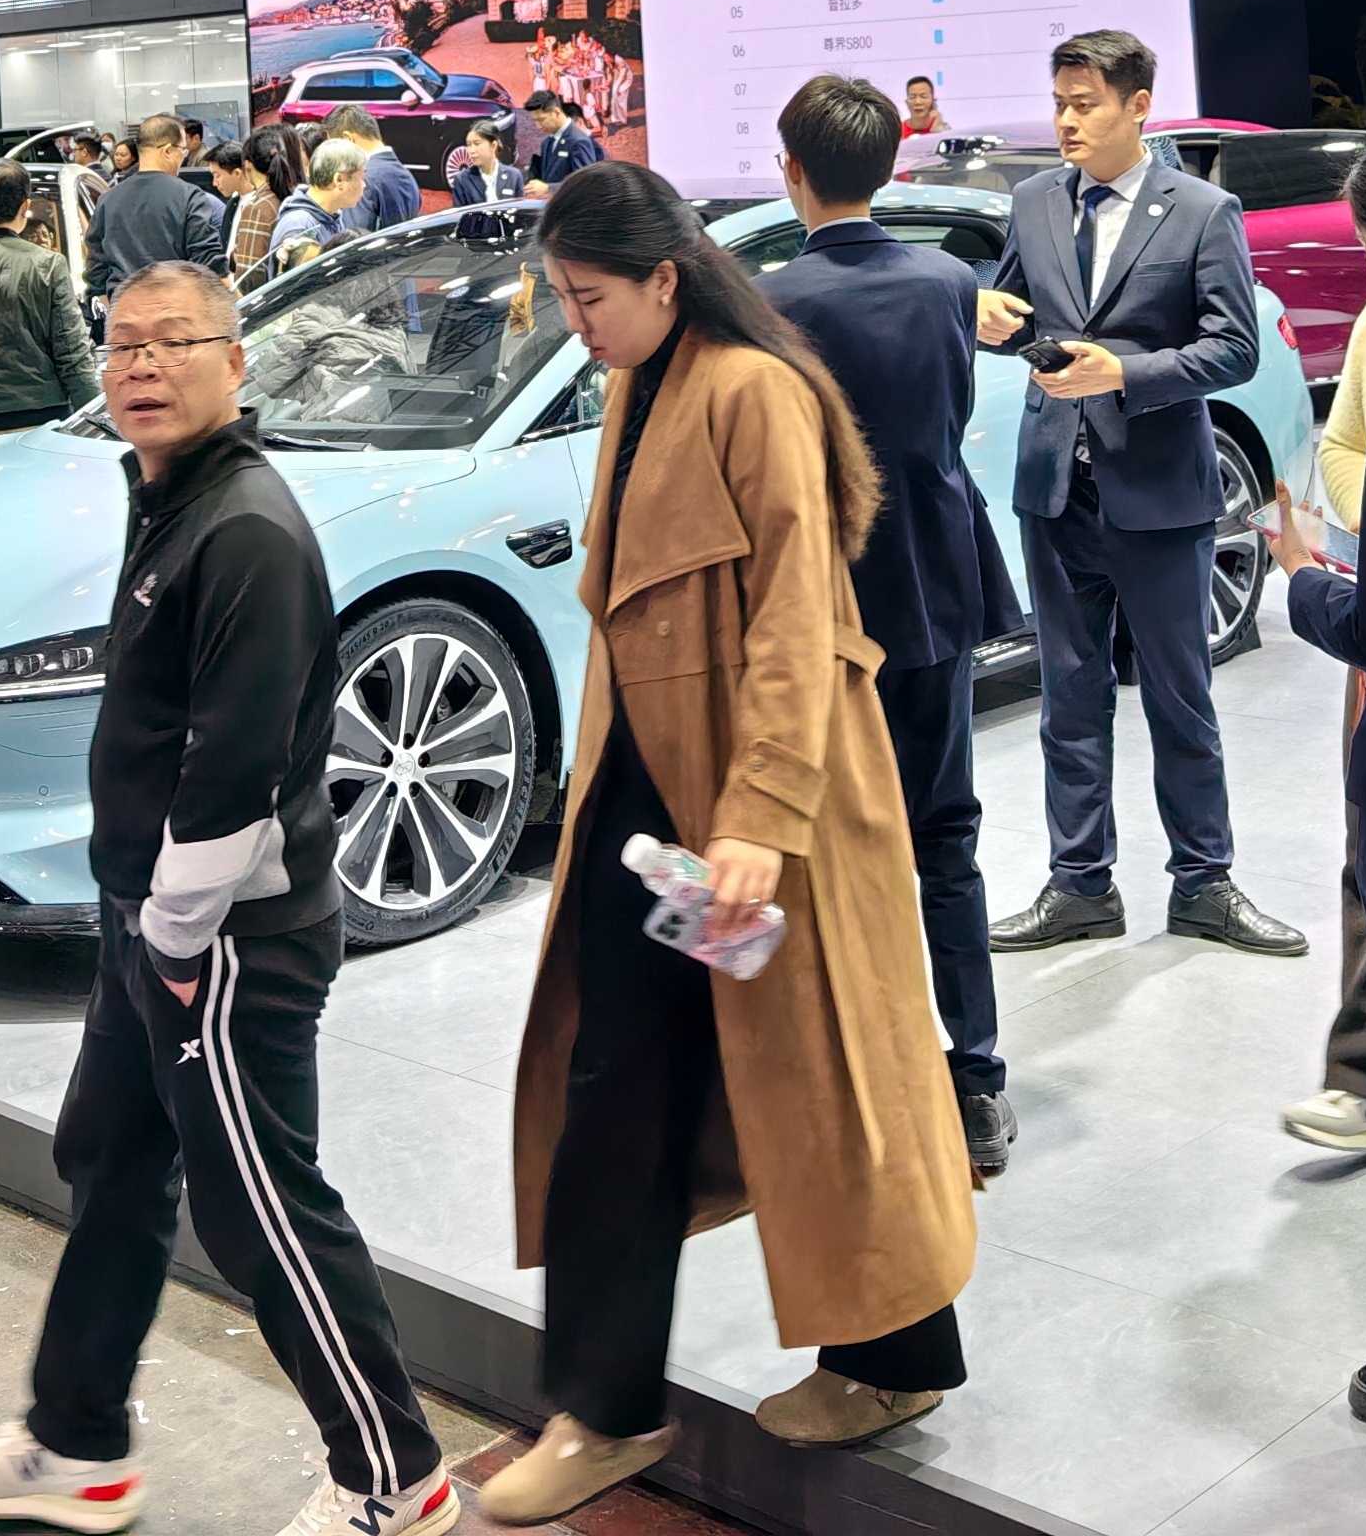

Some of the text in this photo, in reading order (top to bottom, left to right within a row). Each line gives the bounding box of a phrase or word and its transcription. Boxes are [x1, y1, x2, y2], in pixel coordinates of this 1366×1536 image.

[730, 6, 744, 19] 05
[732, 22, 1065, 57] 06 尊界S800 20
[734, 83, 747, 96] 07
[737, 122, 750, 135] 08
[739, 161, 752, 174] 09
